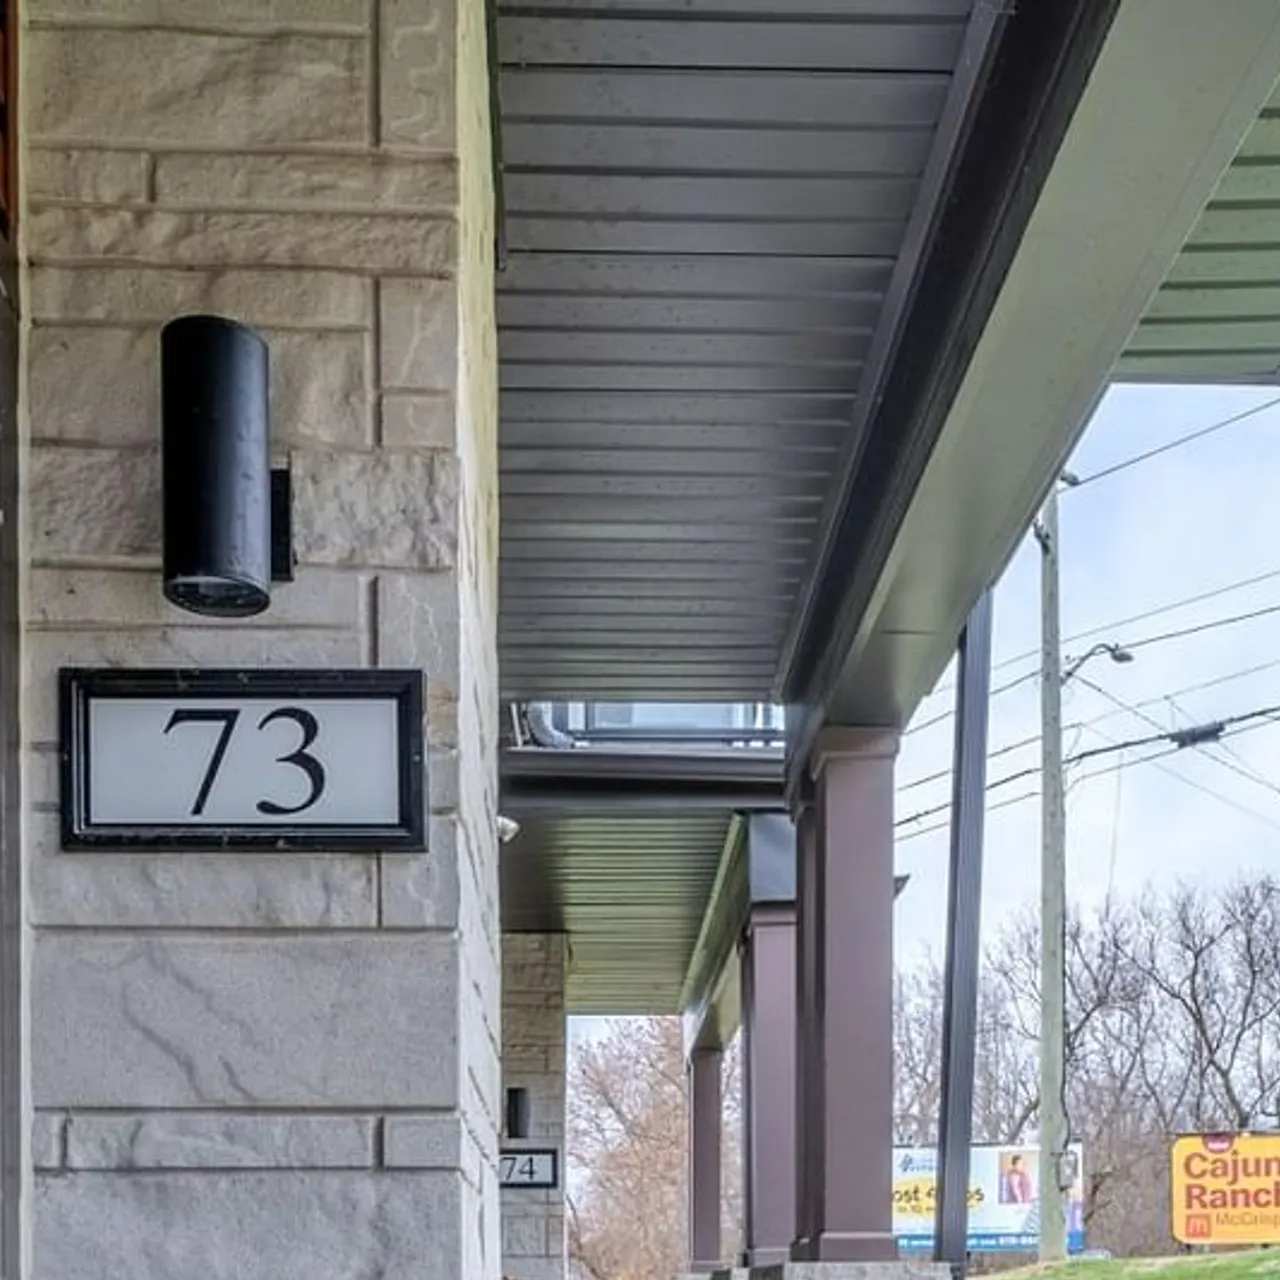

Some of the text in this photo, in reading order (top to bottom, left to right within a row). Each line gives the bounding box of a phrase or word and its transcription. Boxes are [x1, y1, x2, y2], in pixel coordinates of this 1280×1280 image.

[162, 706, 326, 816] 73
[500, 1156, 538, 1181] 74
[893, 1185, 920, 1203] ost
